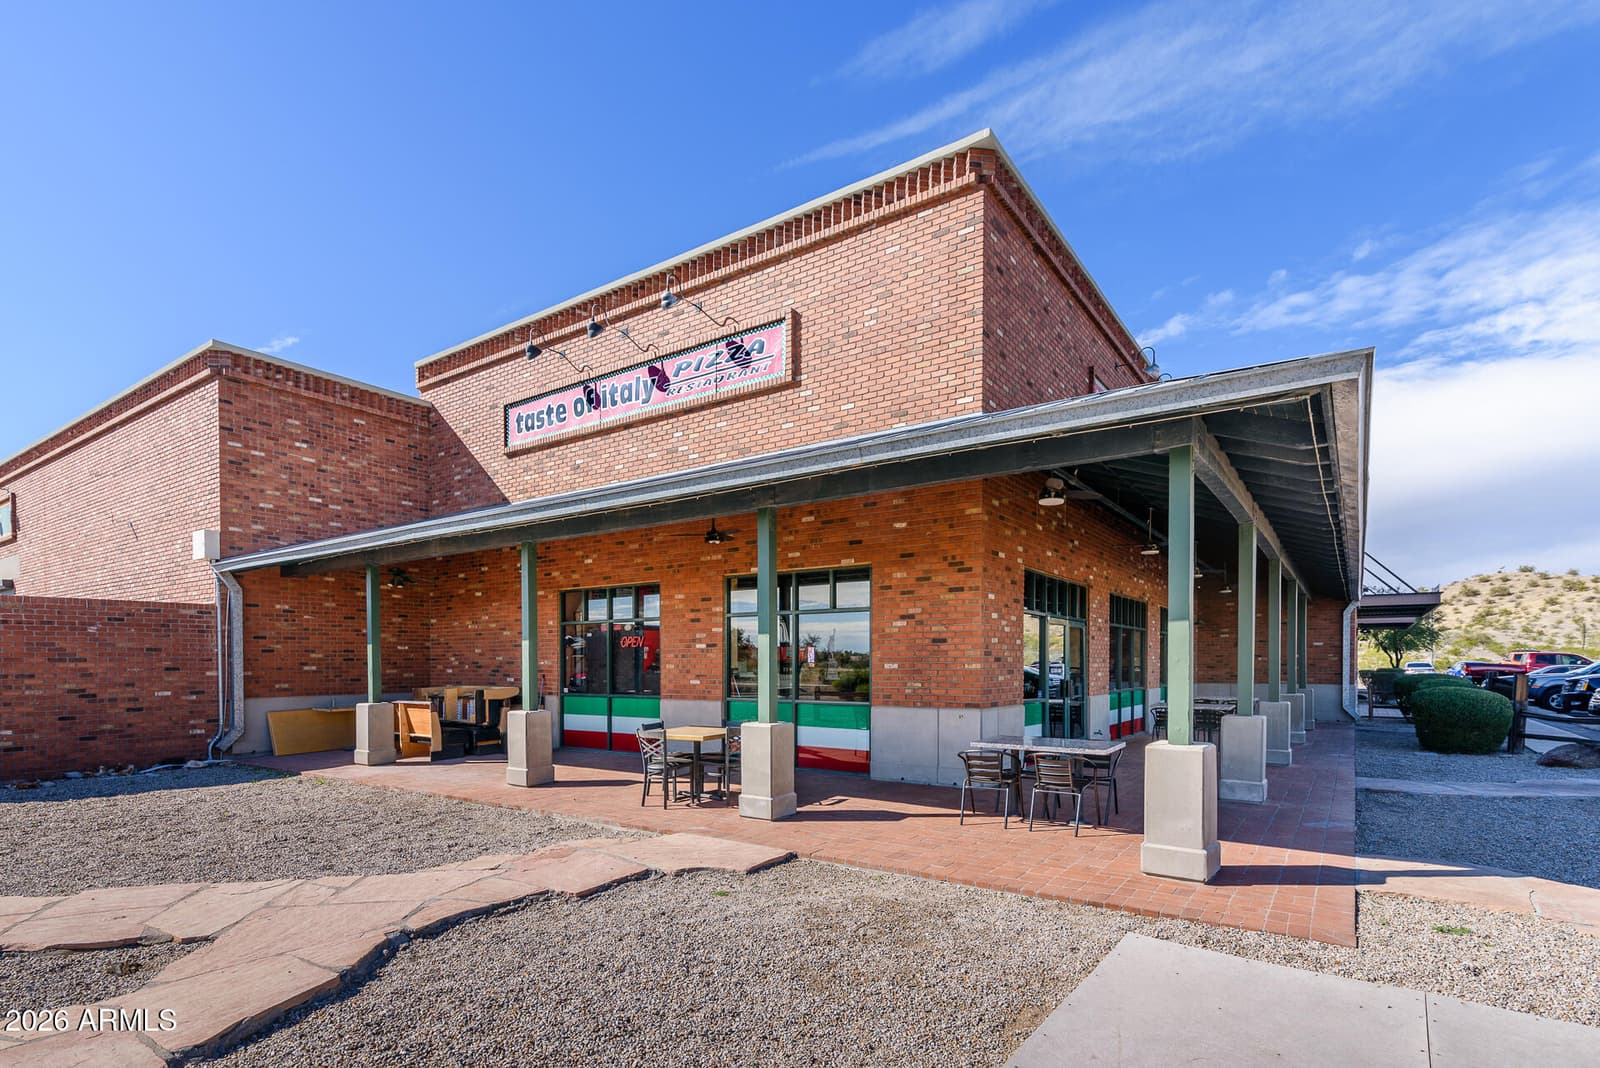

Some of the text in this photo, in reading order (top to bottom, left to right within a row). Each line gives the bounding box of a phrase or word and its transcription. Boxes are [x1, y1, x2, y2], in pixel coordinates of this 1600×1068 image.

[672, 338, 766, 378] PIZZA
[666, 361, 770, 396] RESTAURANT
[515, 376, 657, 434] taste of italy
[620, 636, 644, 648] OPEN
